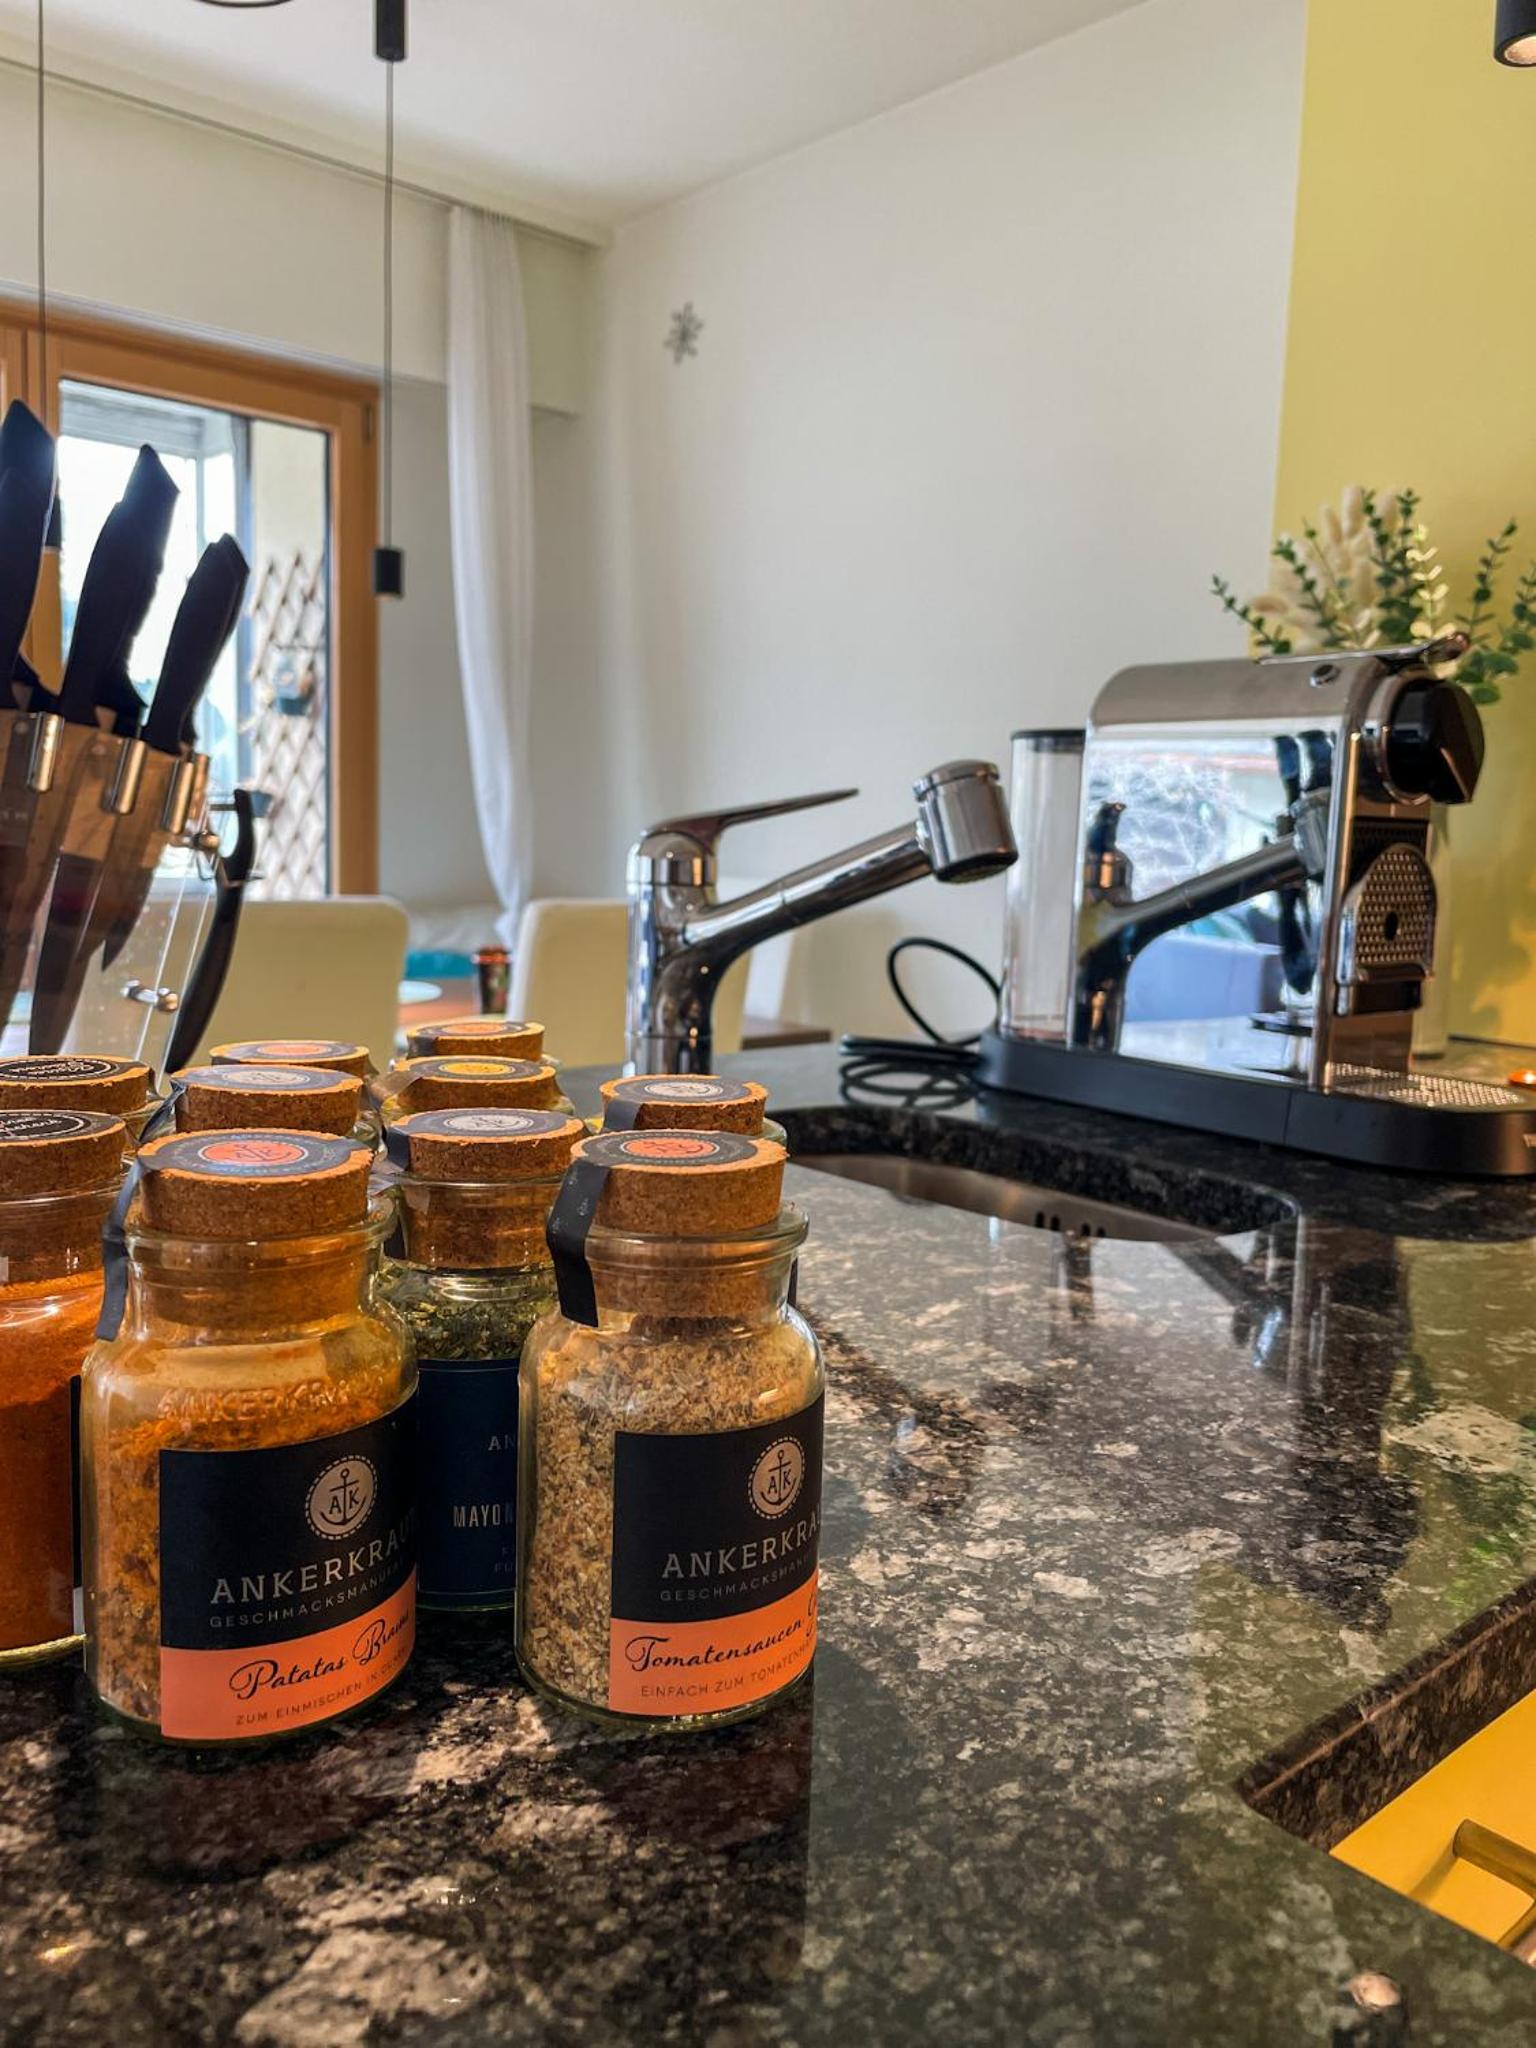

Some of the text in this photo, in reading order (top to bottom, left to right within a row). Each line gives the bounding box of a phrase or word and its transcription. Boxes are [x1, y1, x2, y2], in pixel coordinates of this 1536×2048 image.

[210, 1511, 412, 1604] ANKERKRAU
[625, 1618, 802, 1672] Tomatensaucen
[641, 1637, 813, 1698] EINFACH ZUM TOMATEN
[229, 1656, 345, 1700] Patatas
[235, 1713, 268, 1726] ZUM
[276, 1682, 361, 1719] EINMISCHEN
